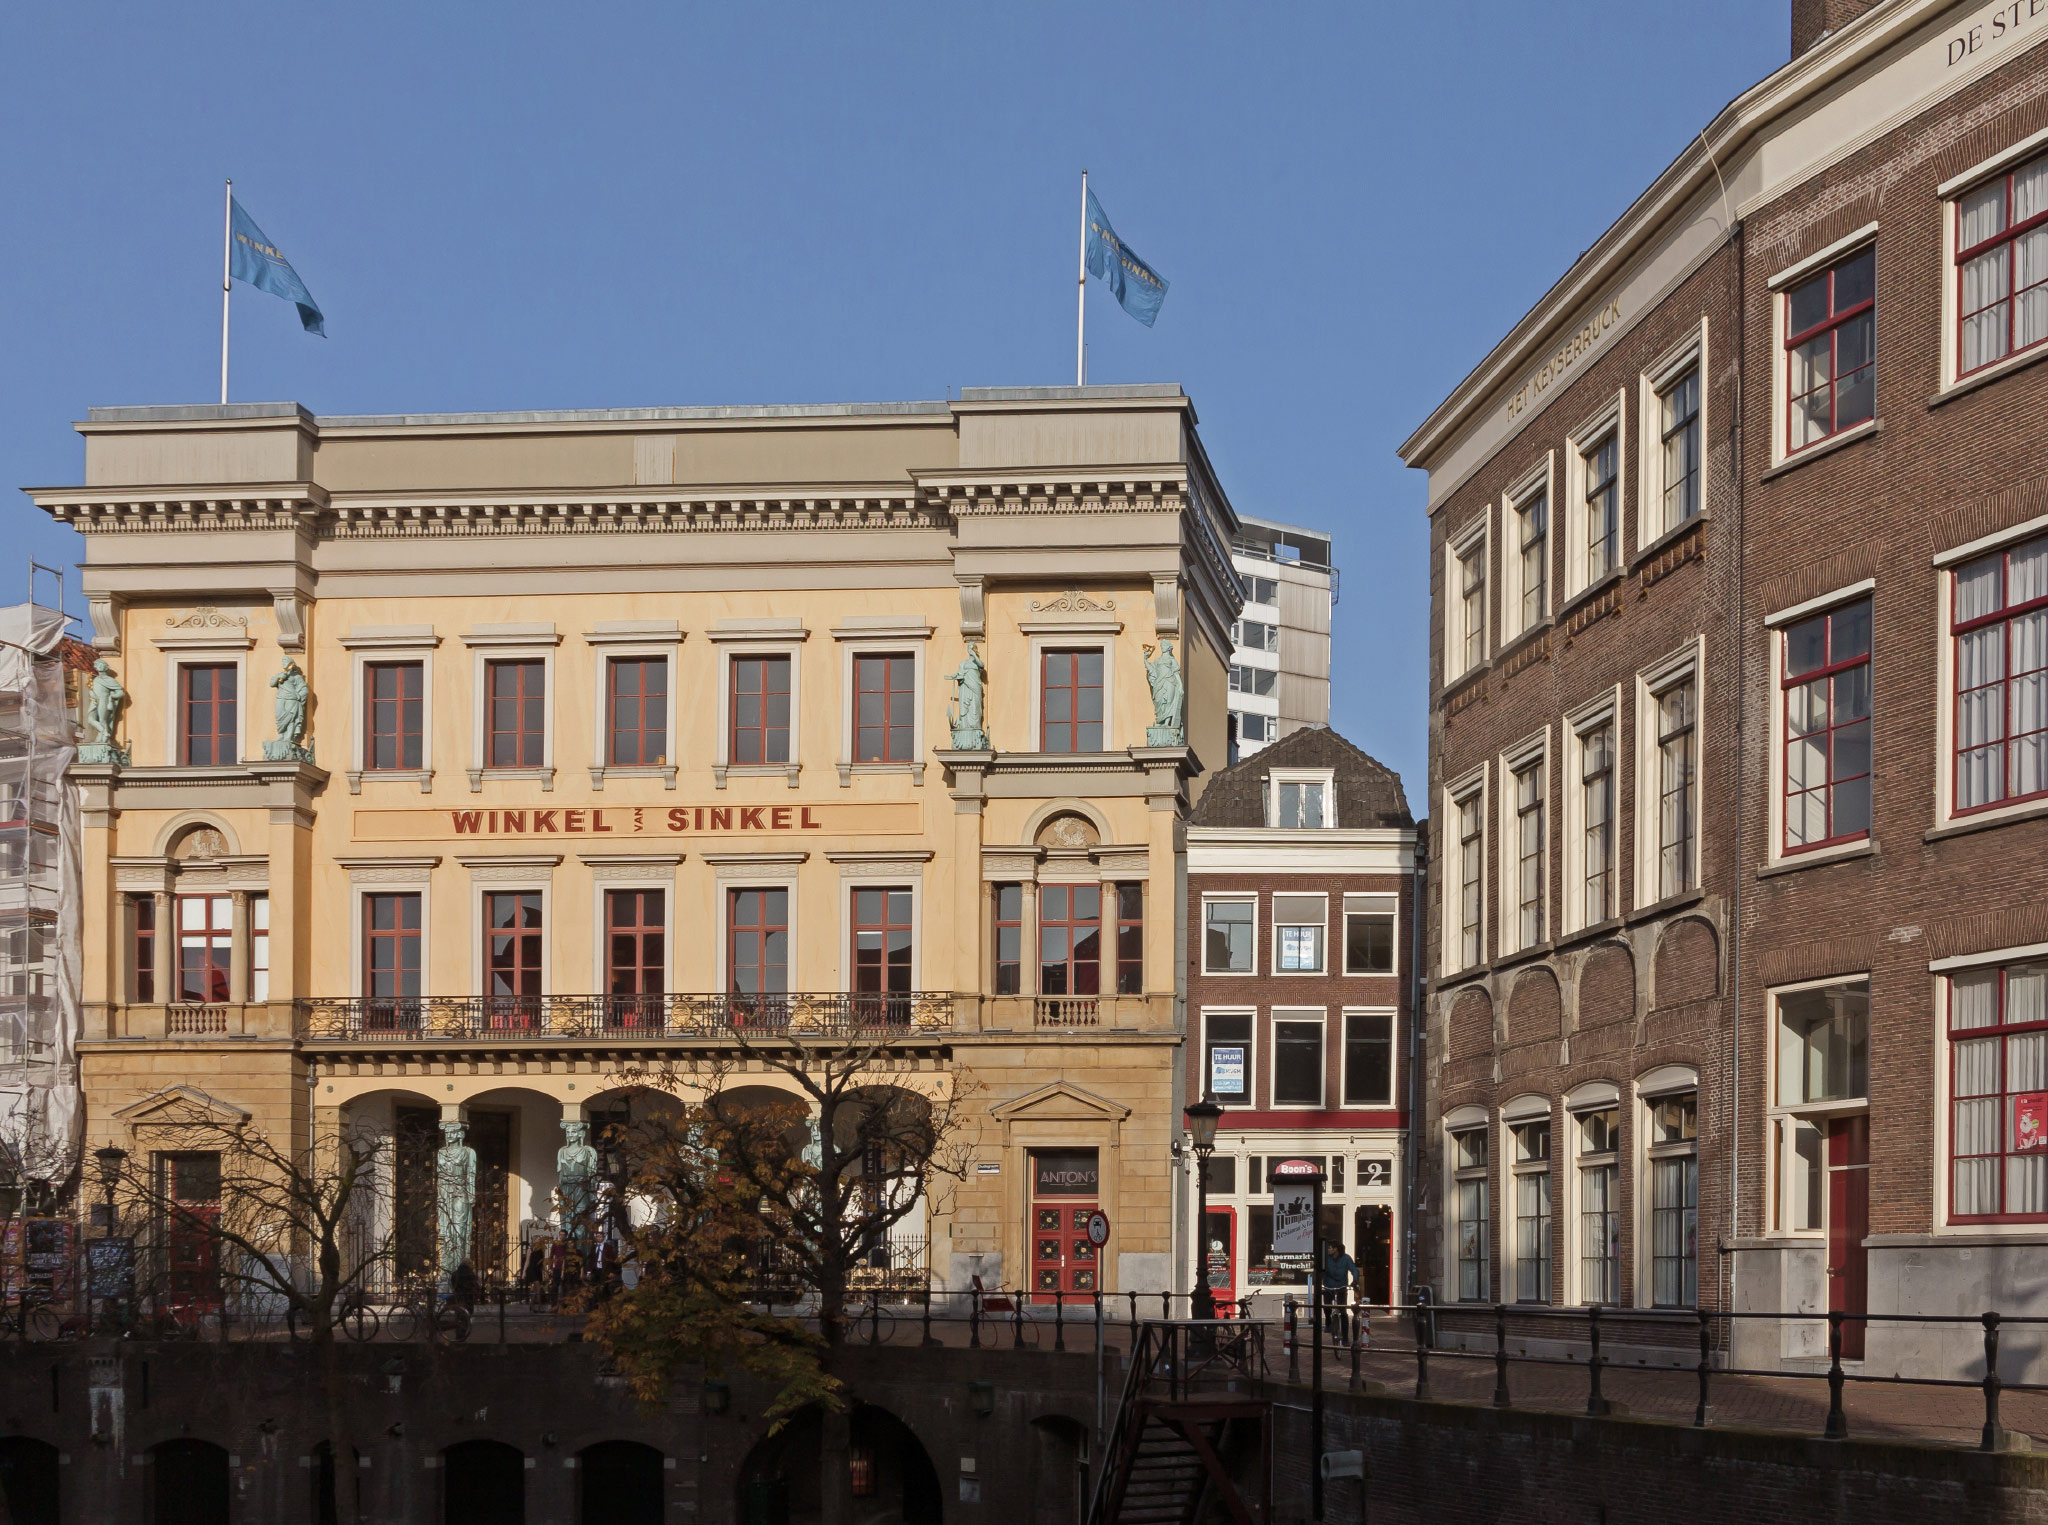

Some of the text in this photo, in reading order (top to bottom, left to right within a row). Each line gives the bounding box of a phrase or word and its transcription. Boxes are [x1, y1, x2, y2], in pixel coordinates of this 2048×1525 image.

[1947, 0, 2048, 67] DE STE
[1506, 383, 1530, 423] HET
[451, 806, 822, 834] WINKEL VAN SINKEL
[1040, 1170, 1097, 1183] ANTON'S
[1281, 1164, 1313, 1174] Boon's
[1367, 1162, 1383, 1186] 2
[1265, 1253, 1311, 1261] supermarkt
